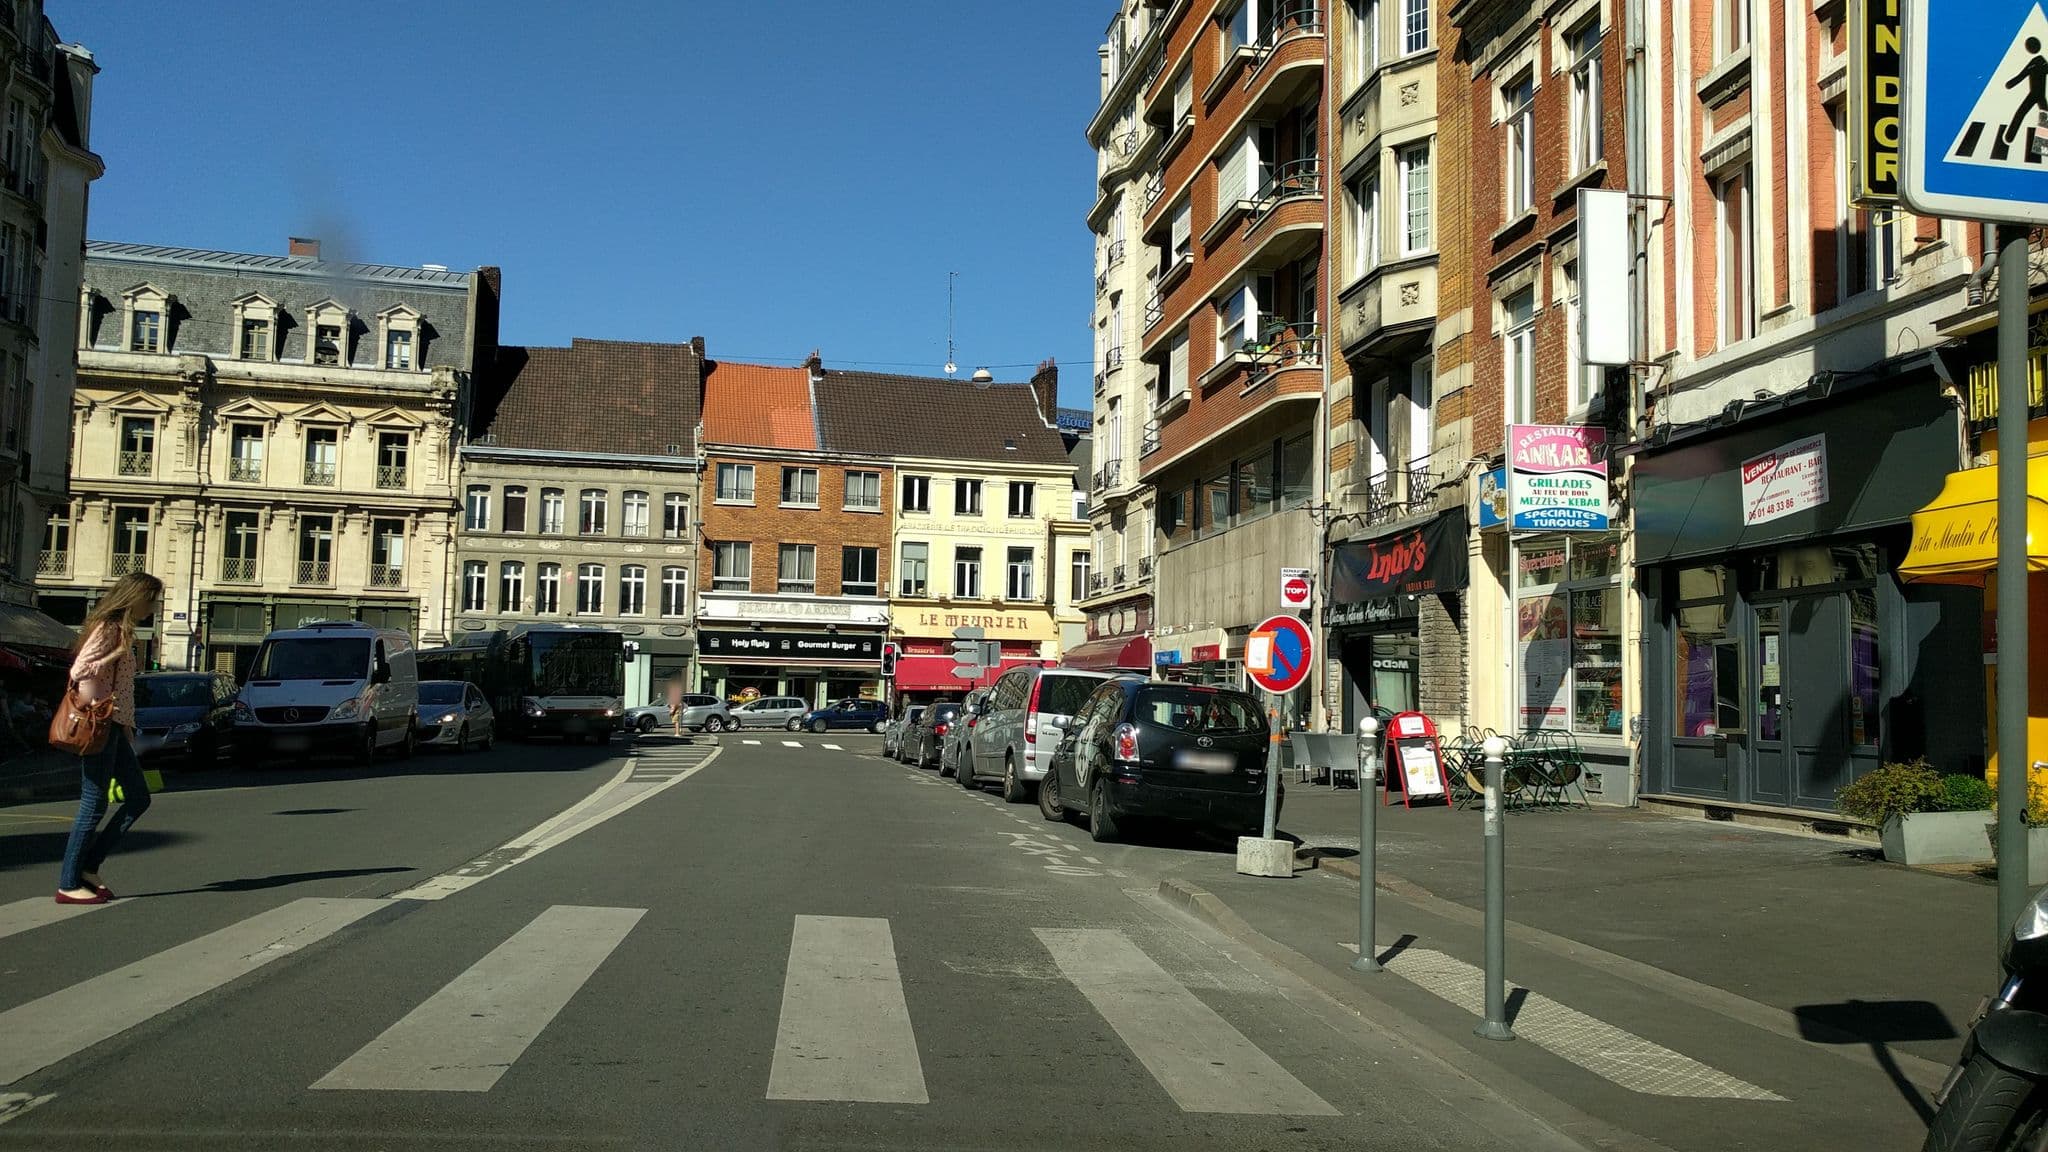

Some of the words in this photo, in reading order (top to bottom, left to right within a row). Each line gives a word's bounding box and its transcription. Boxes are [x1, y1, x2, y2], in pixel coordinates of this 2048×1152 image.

[1516, 443, 1592, 468] ANKAR
[1744, 454, 1776, 482] VENDS
[1761, 463, 1802, 485] RESTAURANT
[1808, 455, 1823, 469] BAR
[1528, 478, 1592, 489] GRILLADES
[1520, 496, 1559, 506] MEZZES
[1568, 497, 1601, 507] KEBAB
[1757, 507, 1765, 518] 01
[1766, 504, 1775, 514] 48
[1776, 501, 1785, 512] 33
[1524, 509, 1598, 521] SPECIALITES
[1532, 519, 1591, 528] TURQUES
[1914, 526, 1930, 552] Au
[1934, 519, 1974, 550] Moulin
[919, 613, 939, 627] LE
[944, 615, 1029, 630] MEUNIER
[731, 638, 749, 648] Holy
[750, 639, 770, 649] Moly
[797, 640, 831, 649] Gourmet
[831, 641, 857, 650] Burger
